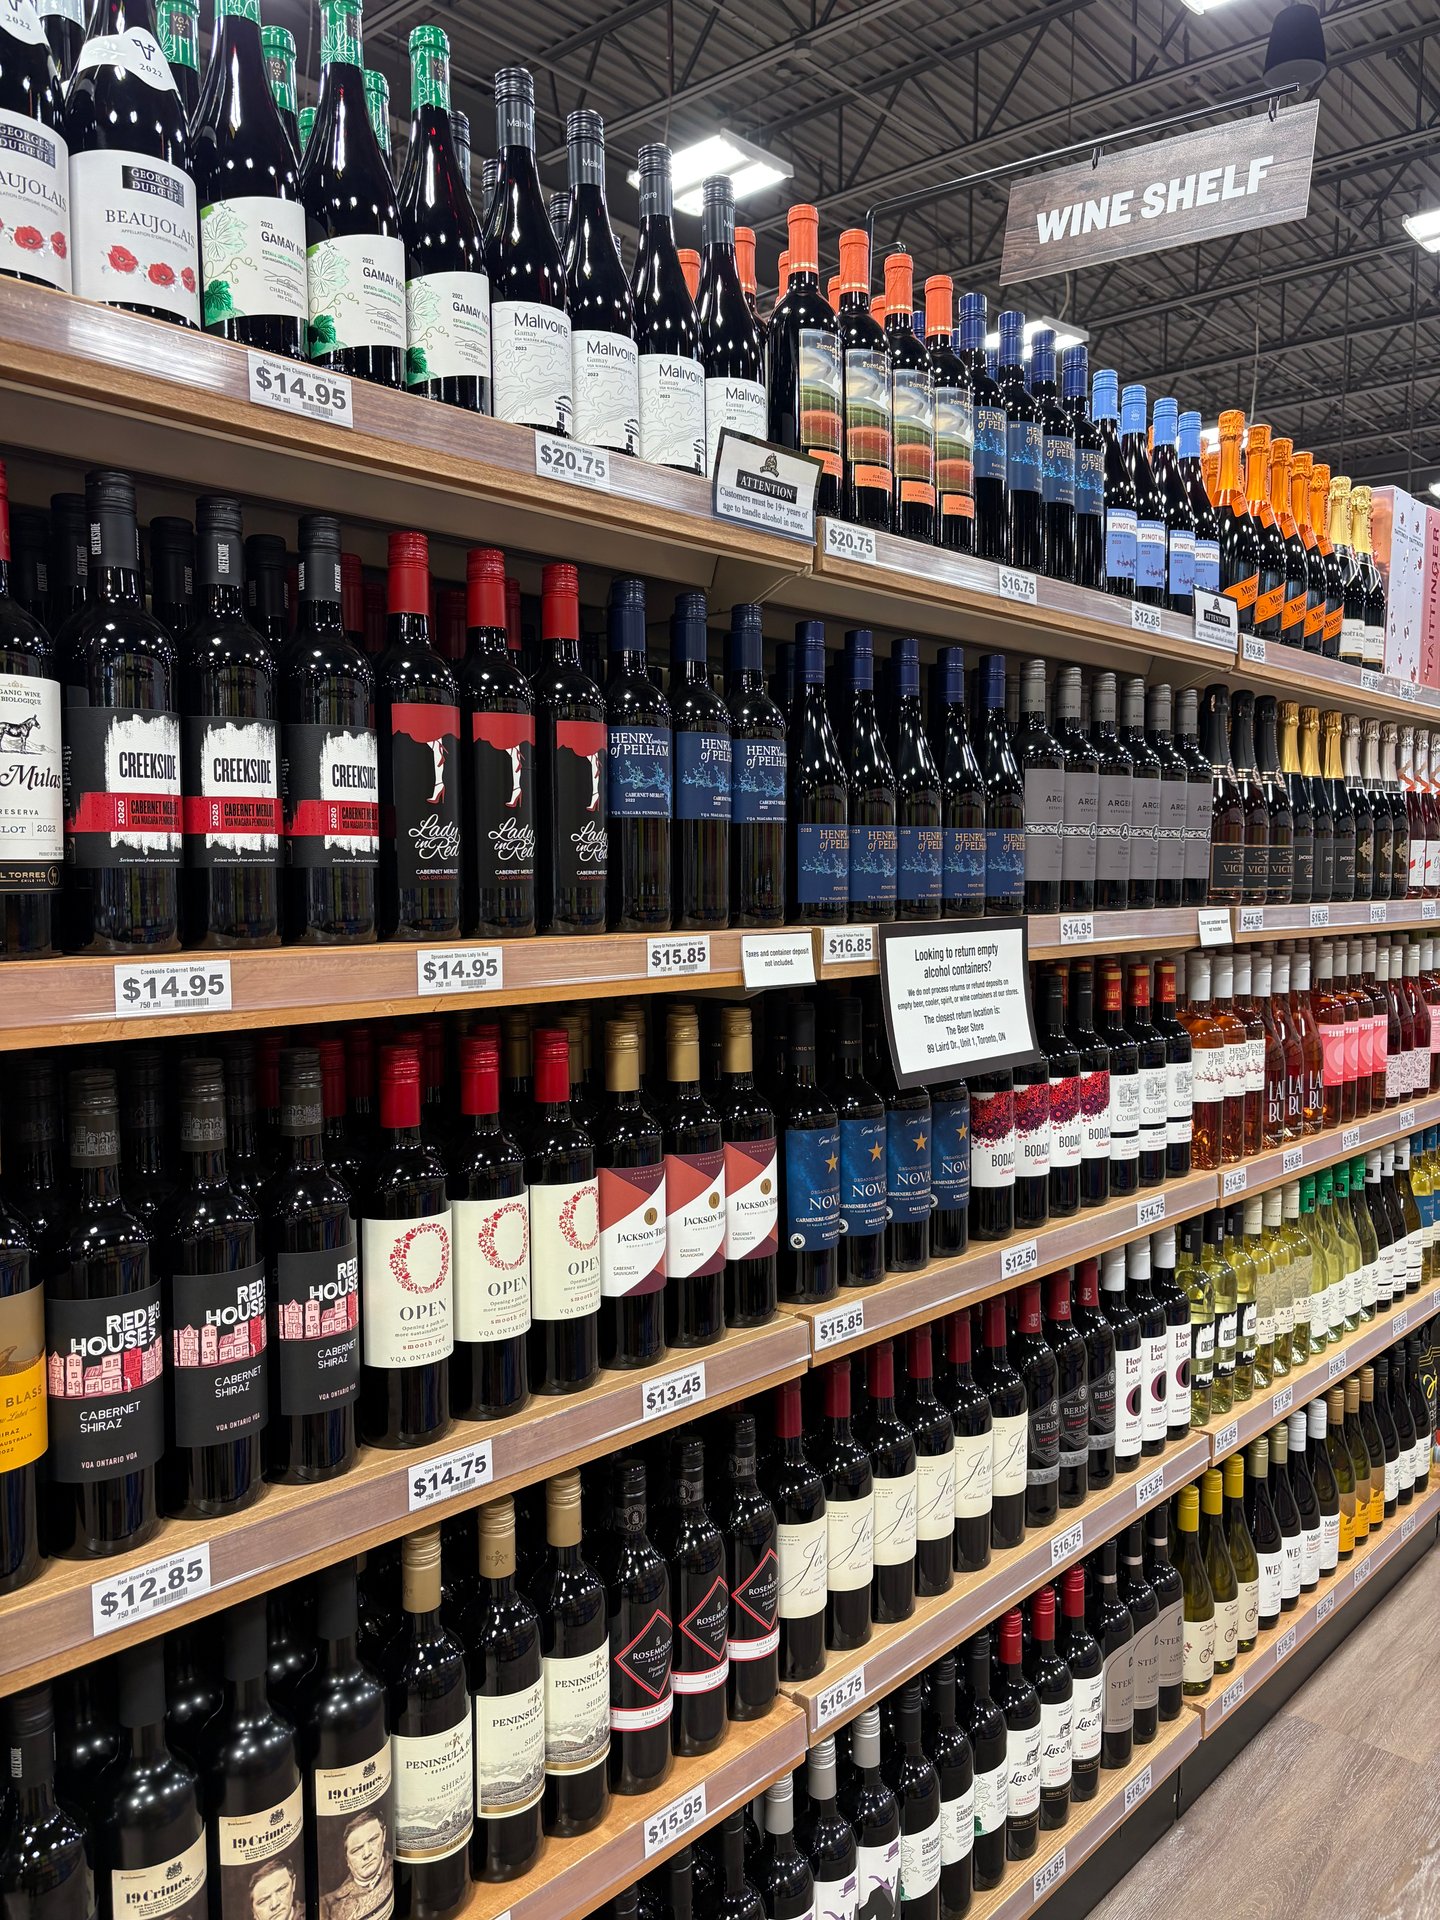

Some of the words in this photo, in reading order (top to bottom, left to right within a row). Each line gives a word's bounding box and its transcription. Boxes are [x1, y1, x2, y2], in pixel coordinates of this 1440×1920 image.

[131, 167, 179, 190] GEORGES
[1036, 190, 1134, 244] WINE
[1140, 155, 1274, 219] SHELF
[105, 209, 195, 248] BEAUJOLAIS
[261, 231, 296, 252] GAMAY
[514, 312, 569, 338] Malivoire
[586, 340, 636, 364] Malivoire
[256, 365, 347, 411] $14.95
[540, 444, 606, 480] $20.75
[740, 475, 793, 500] ATTENTION
[720, 487, 751, 504] Customers
[752, 496, 766, 506] must
[767, 500, 774, 508] be
[775, 502, 786, 511] 19+
[787, 507, 800, 517] years
[802, 511, 809, 519] of
[723, 503, 733, 513] age
[734, 504, 741, 512] to
[742, 506, 761, 519] handle
[762, 512, 782, 524] alcohol
[790, 520, 805, 530] store.
[829, 529, 873, 554] $20.75
[1141, 532, 1158, 541] PINOT
[1000, 577, 1035, 595] $16.75
[1134, 609, 1160, 628] $12.85
[1205, 612, 1230, 625] ATTENTION
[1245, 643, 1265, 657] $19.85
[1, 697, 41, 706] BIOLOGIQUE
[610, 732, 653, 744] HENRY
[610, 744, 622, 758] of
[623, 744, 669, 757] PELHAM
[746, 745, 781, 757] HENRY
[6, 764, 62, 791] Mulas
[119, 751, 177, 781] CREEKSIDE
[213, 758, 272, 784] CREEKSIDE
[332, 763, 377, 790] CREEKSIDE
[117, 800, 125, 825] 2020
[408, 813, 460, 845] Lady
[414, 838, 430, 849] in
[419, 836, 460, 861] Red
[1242, 915, 1263, 926] $44.95
[1311, 911, 1329, 923] $16.95
[1063, 922, 1092, 937] $14.95
[652, 946, 706, 967] $15.85
[745, 949, 760, 958] Taxes
[760, 949, 769, 957] and
[769, 948, 792, 957] container
[792, 947, 809, 956] deposit
[829, 938, 872, 954] $16.85
[914, 948, 944, 962] Looking
[946, 948, 953, 958] to
[955, 945, 976, 957] return
[977, 943, 999, 957] empty
[140, 967, 165, 975] Creekside
[189, 965, 205, 973] Merlot
[423, 958, 498, 984] $14.95
[773, 958, 794, 967] included.
[924, 964, 950, 979] alcohol
[952, 960, 992, 976] containers?
[122, 973, 225, 1004] $14.95
[898, 1001, 913, 1011] empty
[913, 1000, 925, 1009] beer,
[925, 997, 940, 1007] cooler,
[940, 996, 954, 1005] spirit,
[970, 990, 993, 1000] containers
[1005, 988, 1019, 996] stores.
[907, 989, 915, 997] We
[922, 987, 930, 995] not
[931, 986, 949, 996] process
[949, 984, 966, 992] returns
[971, 981, 985, 989] refund
[985, 979, 1003, 989] deposits
[924, 1014, 934, 1025] The
[935, 1011, 956, 1024] closest
[956, 1010, 972, 1020] return
[972, 1007, 993, 1018] location
[946, 1025, 956, 1036] The
[957, 1024, 969, 1034] Beer
[970, 1022, 984, 1033] Store
[926, 1044, 935, 1054] 89
[935, 1040, 949, 1052] Laird
[949, 1040, 961, 1050] Dr.,
[960, 1037, 972, 1048] Unit
[977, 1033, 998, 1045] Toronto,
[998, 1031, 1007, 1041] ON
[1284, 1155, 1302, 1169] $18.65
[896, 1171, 931, 1186] NOVA
[1225, 1176, 1246, 1190] $14.50
[1140, 1201, 1165, 1221] $14.75
[1005, 1248, 1037, 1272] $12.50
[237, 1279, 263, 1305] RED
[488, 1276, 528, 1297] OPEN
[206, 1296, 264, 1326] HOUSE
[399, 1297, 447, 1321] OPEN
[106, 1308, 146, 1335] RED
[820, 1312, 863, 1341] $15.85
[70, 1327, 147, 1357] HOUSE
[402, 1340, 433, 1350] smooth
[435, 1335, 445, 1344] red
[1126, 1366, 1138, 1375] Lot
[6, 1384, 42, 1408] BLASS
[215, 1381, 250, 1398] SHIRAZ
[646, 1375, 702, 1411] $13.45
[79, 1400, 140, 1421] CABERNET
[1273, 1394, 1291, 1410] $11.90
[80, 1419, 122, 1433] SHIRAZ
[1216, 1427, 1237, 1449] $14.95
[413, 1454, 488, 1500] $14.75
[1139, 1475, 1164, 1500] $13.25
[1053, 1530, 1082, 1558] $16.75
[117, 1579, 128, 1587] Red
[128, 1572, 145, 1583] House
[145, 1562, 169, 1576] Cabernet
[169, 1556, 185, 1568] Shiraz
[100, 1558, 204, 1618] $12.85
[648, 1660, 667, 1674] Diamond
[651, 1668, 664, 1679] Label
[820, 1676, 862, 1716] $18.75
[492, 1702, 542, 1728] PENINSULA
[405, 1745, 465, 1770] PENINSULA
[1043, 1743, 1060, 1759] Las
[328, 1788, 341, 1800] 19
[343, 1773, 384, 1797] Crimes
[1009, 1770, 1027, 1787] Las
[1126, 1773, 1152, 1804] $18.75
[648, 1795, 702, 1844] $15.95
[232, 1837, 247, 1849] 19
[249, 1820, 292, 1846] Crimes
[1035, 1856, 1065, 1892] $13.85
[125, 1892, 141, 1904] 19
[146, 1874, 194, 1903] Crimes
